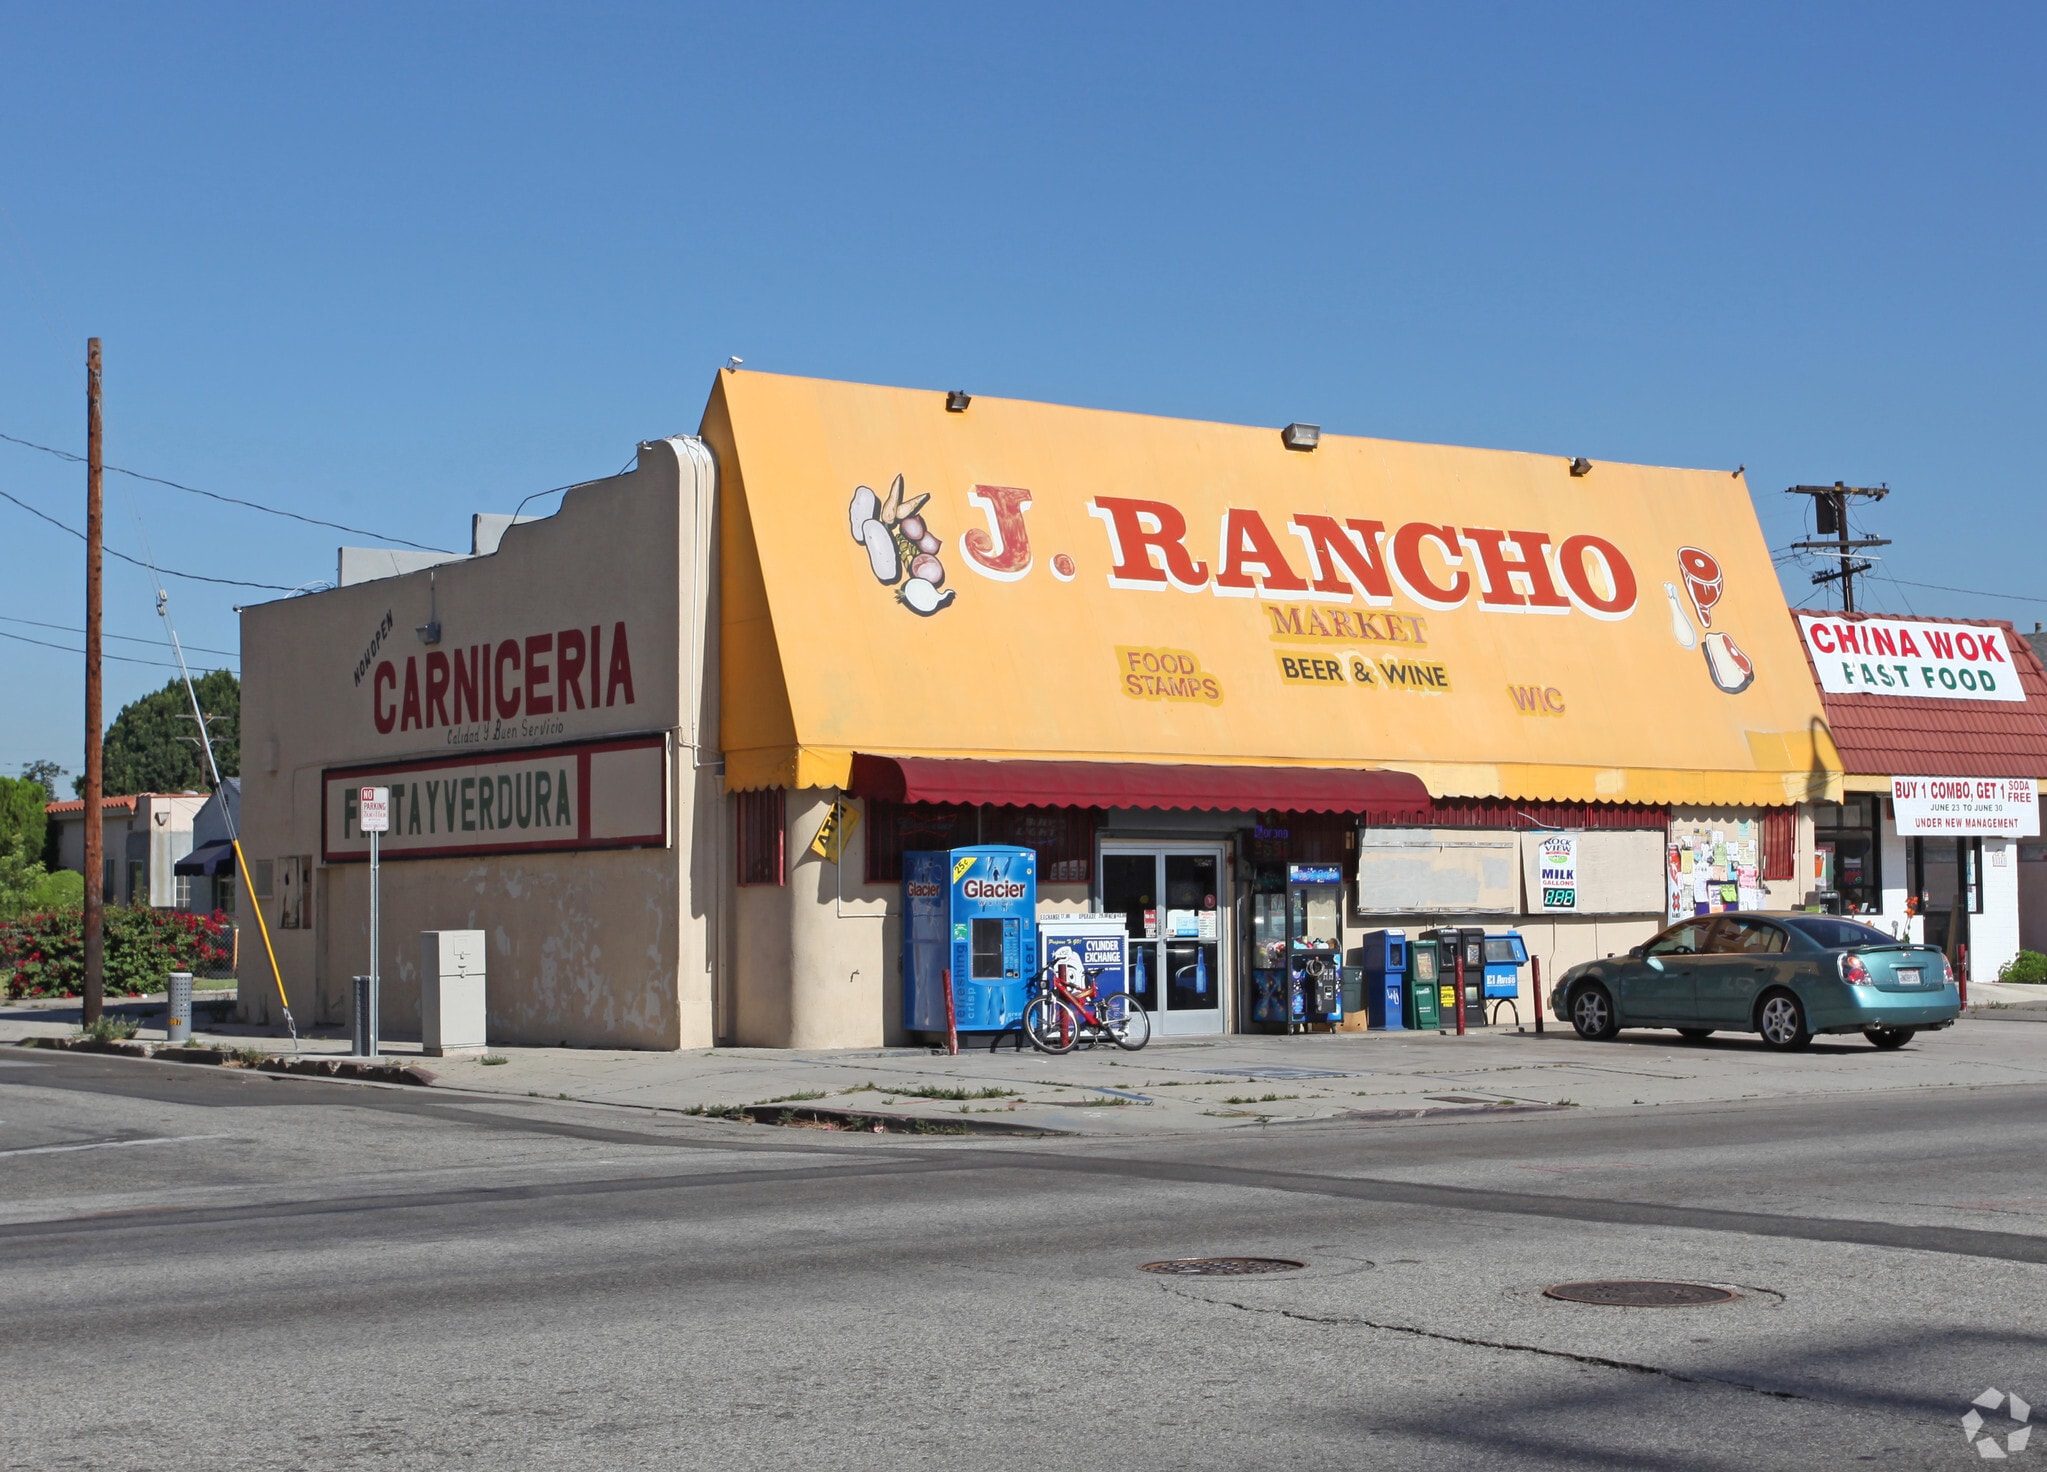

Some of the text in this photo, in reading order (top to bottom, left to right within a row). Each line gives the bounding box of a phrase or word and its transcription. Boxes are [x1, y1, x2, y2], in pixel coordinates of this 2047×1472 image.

[959, 484, 1637, 621] J. RANCHO
[1269, 606, 1427, 643] MARKET
[354, 609, 393, 687] NOW OPEN
[1810, 623, 2005, 662] CHINA WOK
[1127, 652, 1195, 675] FOOD
[1281, 657, 1448, 687] BEER & WINE
[374, 621, 635, 735] CARNICERIA
[1125, 674, 1219, 700] STAMPS
[1842, 661, 1996, 691] FAST FOOD
[1509, 686, 1566, 713] WIC
[447, 727, 481, 745] Calidad
[492, 717, 518, 741] Buen
[521, 716, 564, 737] Servicio
[363, 789, 373, 800] NO
[1895, 781, 2006, 802] BUY 1 COMBO, GET 1
[2007, 792, 2032, 803] FREE
[2008, 780, 2030, 792] SODA
[344, 769, 571, 839] FTAYVERDURA
[363, 802, 387, 811] PARKING
[1930, 803, 2003, 812] JUNE 23 TO JUNE 30
[818, 802, 847, 849] ATM
[1915, 818, 2018, 829] UNDER NEW MANAGEMENT
[1544, 845, 1572, 853] VIEW
[1542, 869, 1574, 880] MILK
[906, 882, 941, 897] Glacier
[964, 880, 1026, 898] Glacier
[1085, 951, 1121, 963] EXCHANGE
[1086, 940, 1119, 952] CYLINDER
[955, 943, 968, 1025] refreshing
[1486, 974, 1496, 985] El
[967, 986, 976, 1019] crisp
